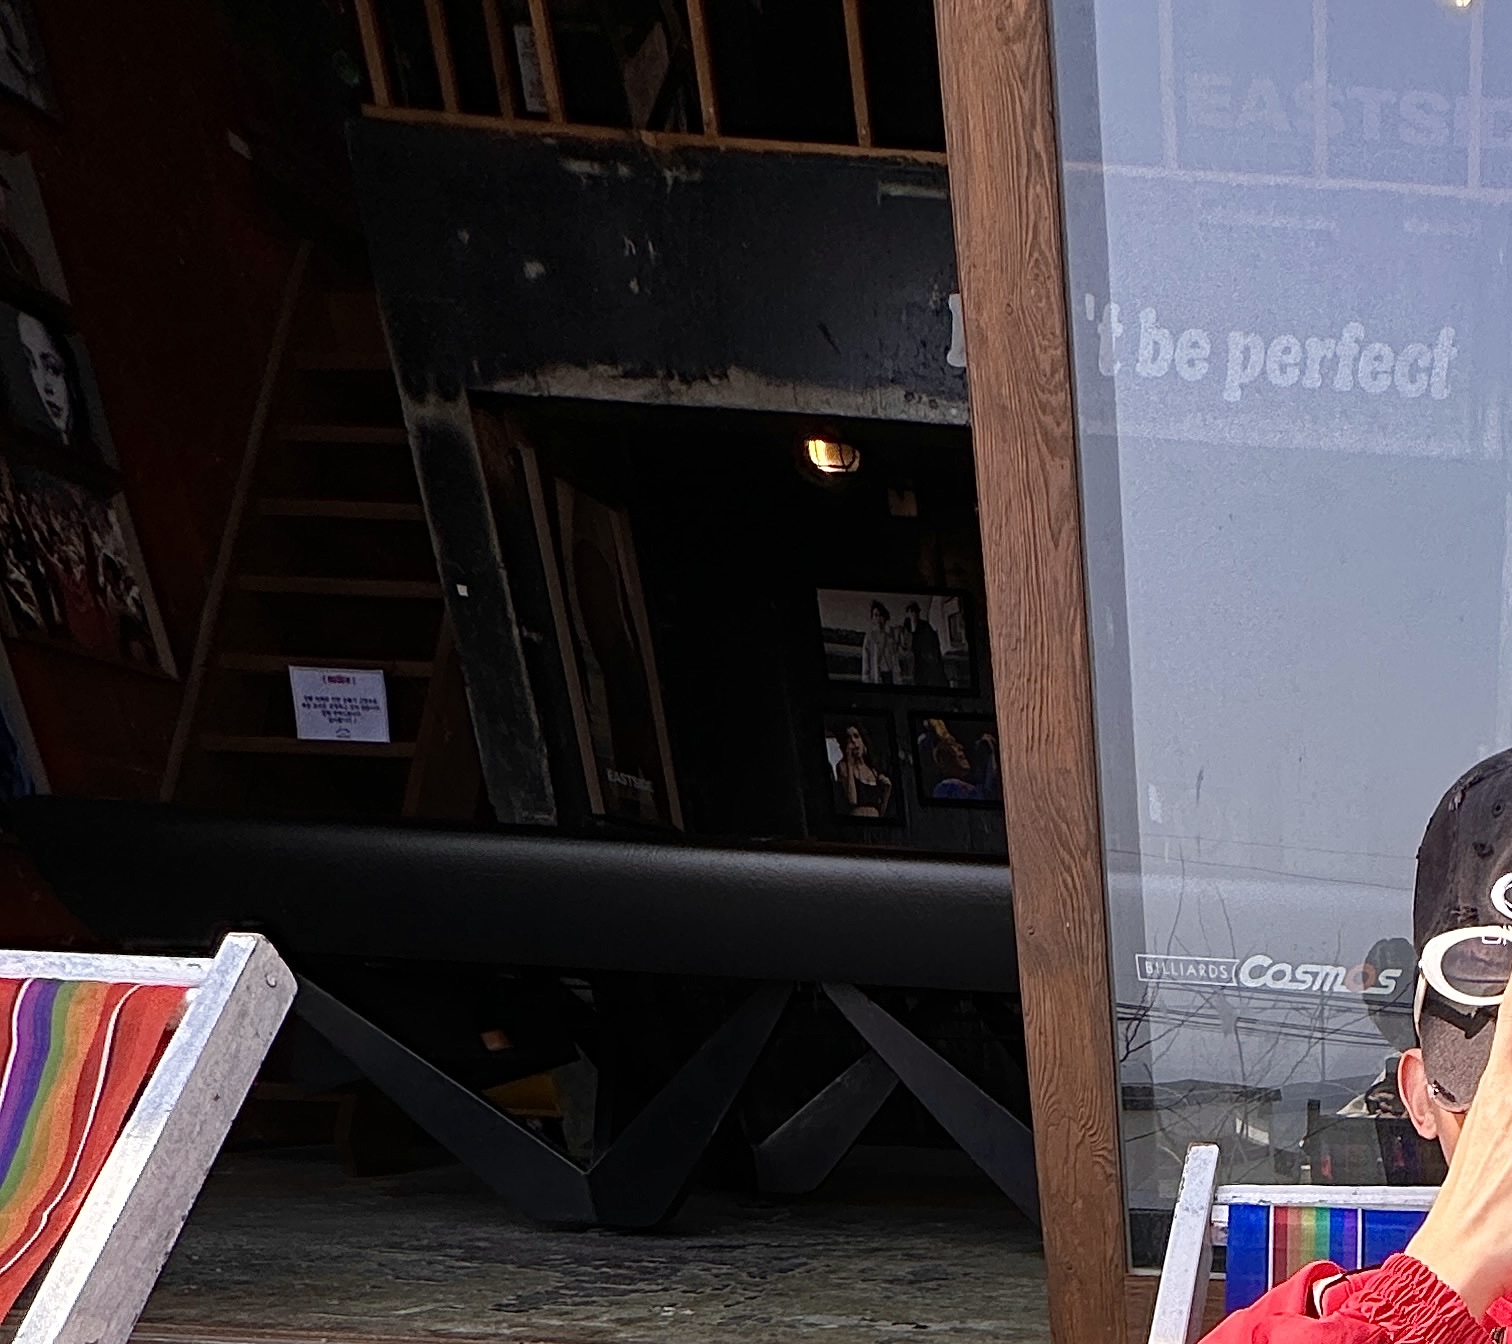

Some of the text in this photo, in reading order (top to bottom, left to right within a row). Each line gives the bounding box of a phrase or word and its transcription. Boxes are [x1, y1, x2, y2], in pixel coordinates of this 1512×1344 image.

[1136, 307, 1211, 381] be
[1223, 321, 1458, 402] perfect
[1144, 958, 1229, 979] BILLIARDS
